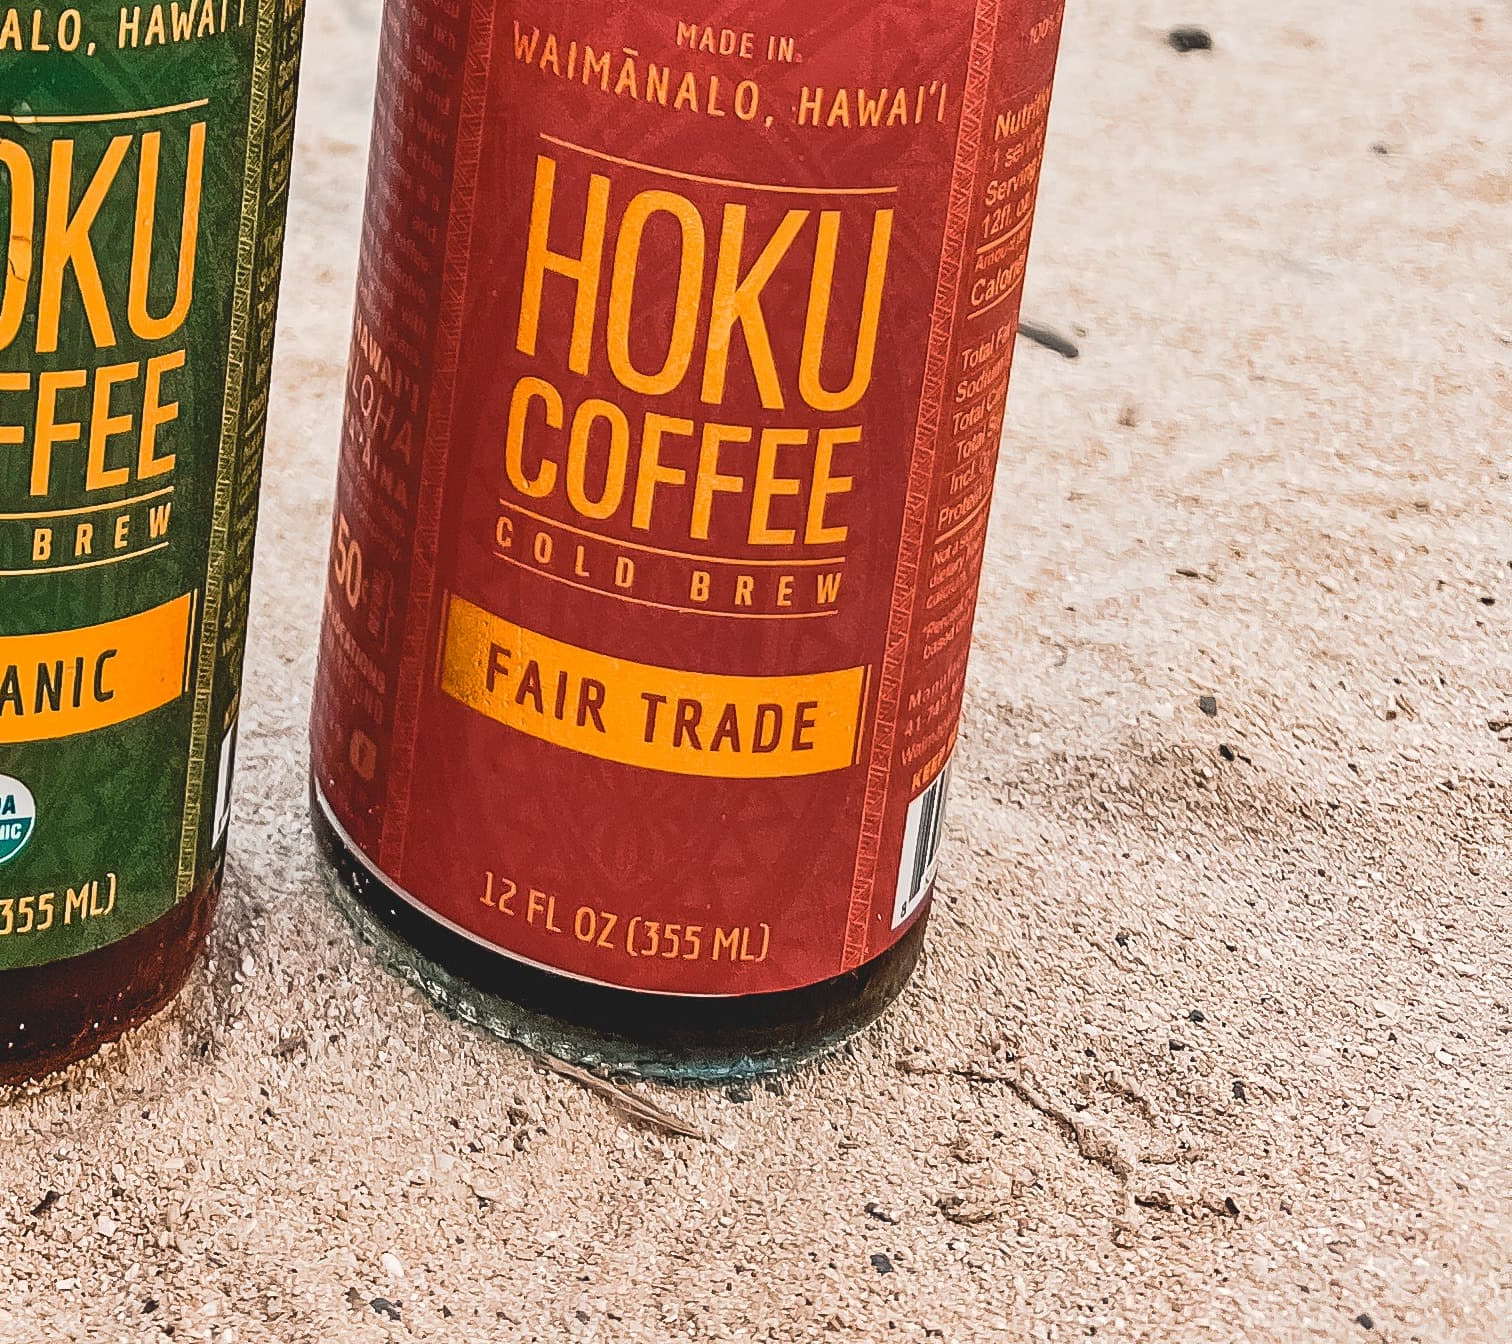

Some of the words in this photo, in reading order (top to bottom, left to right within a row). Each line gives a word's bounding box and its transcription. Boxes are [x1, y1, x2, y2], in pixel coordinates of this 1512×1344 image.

[675, 20, 754, 60] MADE
[767, 34, 795, 64] IN
[516, 154, 893, 410] HOKU
[505, 376, 862, 547] COFFEE
[32, 503, 173, 562] BREW
[495, 515, 636, 590] COLD
[689, 570, 843, 607] BREW
[485, 641, 608, 735] FAIR
[640, 690, 819, 754] TRADE
[63, 873, 118, 919] ML)
[480, 869, 516, 917] 12
[526, 890, 563, 935] FL
[574, 907, 616, 950] OZ
[627, 914, 702, 962] (355
[713, 921, 771, 963] ML)
